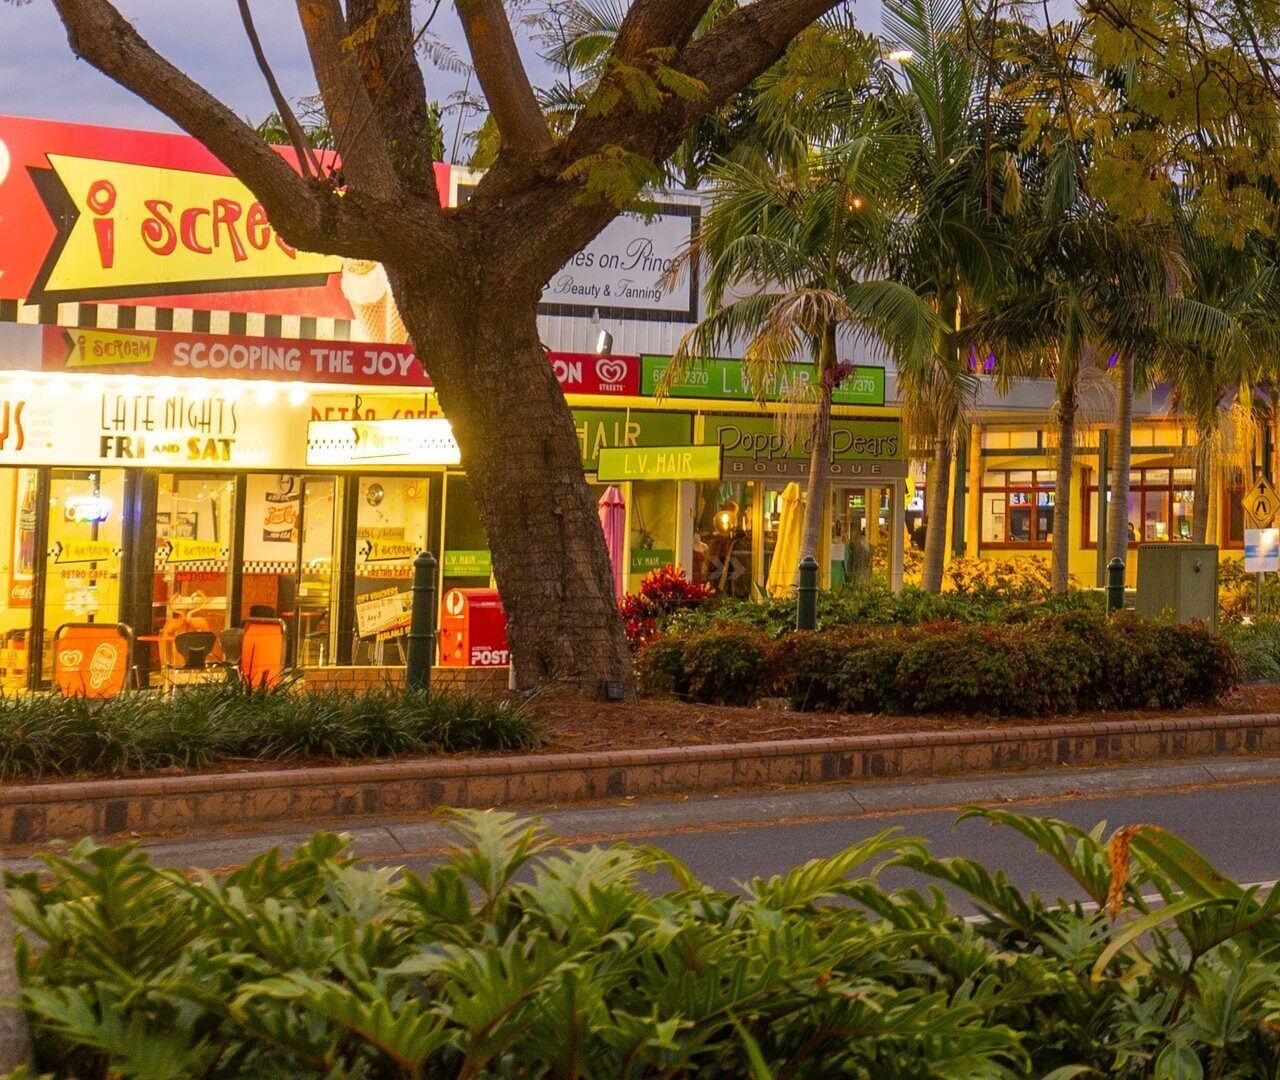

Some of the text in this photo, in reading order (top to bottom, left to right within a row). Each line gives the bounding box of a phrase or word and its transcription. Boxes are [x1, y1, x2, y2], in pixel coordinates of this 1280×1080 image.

[599, 253, 619, 269] on
[553, 274, 662, 302] Beauty & Tanning
[172, 341, 415, 376] SCOOPING THE JOY
[684, 370, 708, 384] 7370
[852, 378, 875, 392] 7370
[598, 384, 624, 392] STREETS
[101, 393, 237, 434] LATE NIGHTS
[99, 435, 236, 461] FRI AND SAT
[574, 420, 641, 460] HAIR
[716, 424, 797, 460] Poppy
[828, 428, 898, 463] Pears
[624, 452, 692, 474] L.V. HAIR
[733, 462, 881, 475] BOUTQUE
[459, 554, 477, 566] HAIR
[61, 569, 108, 579] RETRO CAFE
[370, 568, 411, 578] RETRO CAFE
[368, 586, 399, 602] VOUCHERS
[471, 649, 509, 666] POST
